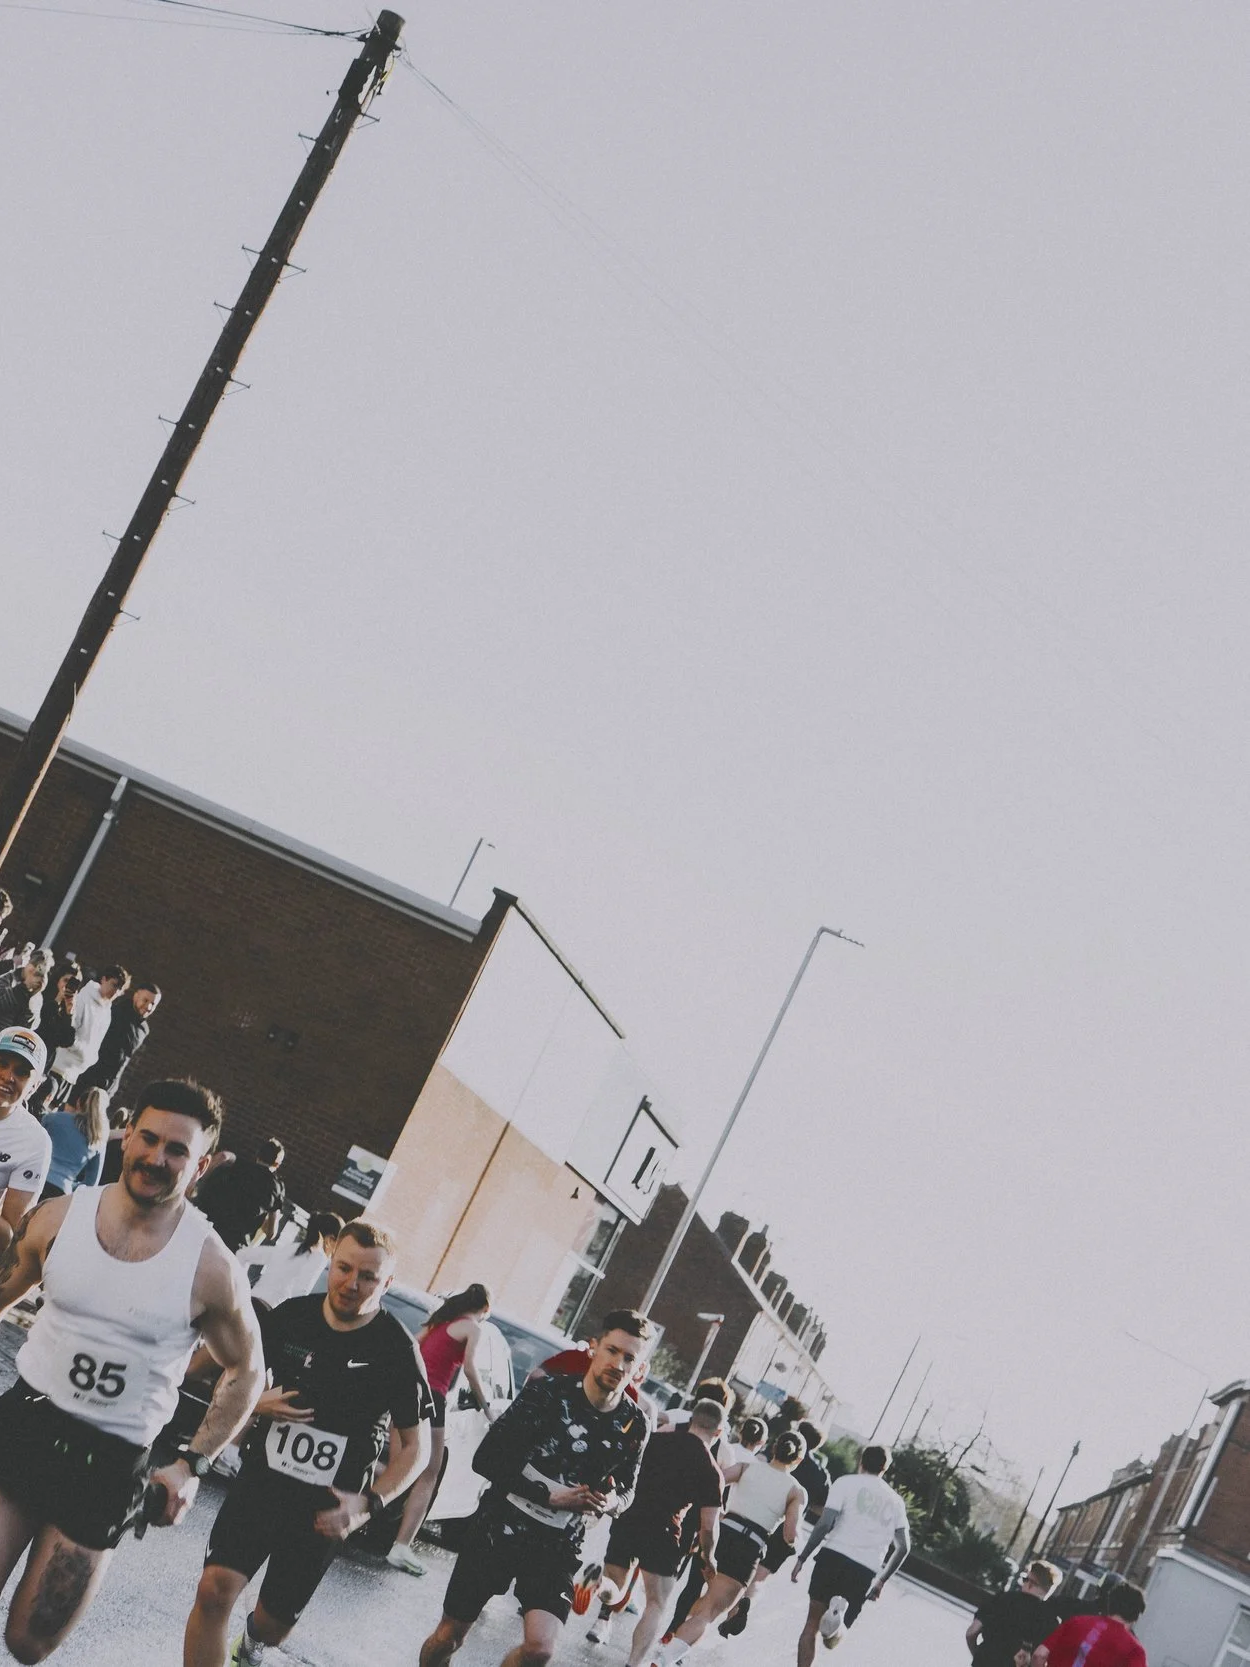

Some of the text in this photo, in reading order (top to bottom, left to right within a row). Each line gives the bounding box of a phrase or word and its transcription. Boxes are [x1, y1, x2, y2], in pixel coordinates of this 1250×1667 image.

[343, 1170, 361, 1183] Parking
[68, 1351, 128, 1399] 85
[276, 1423, 339, 1472] 108
